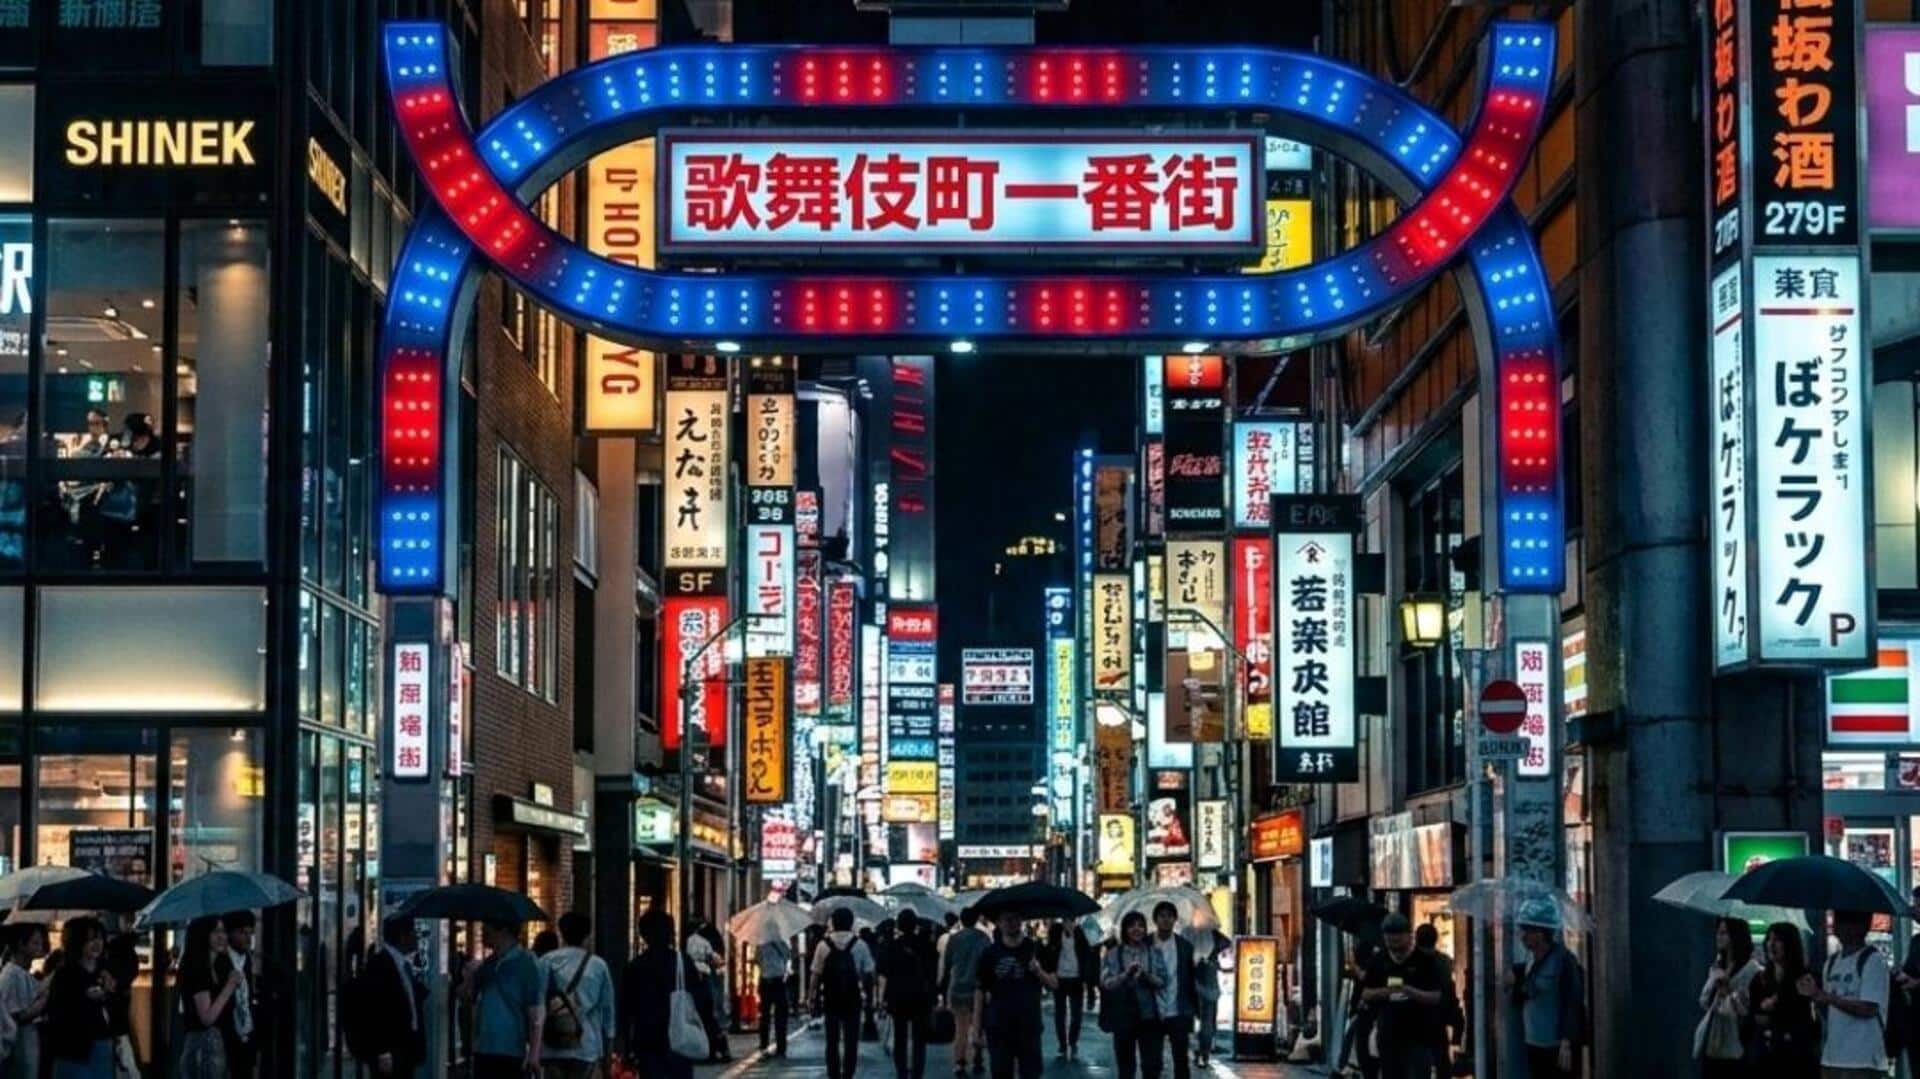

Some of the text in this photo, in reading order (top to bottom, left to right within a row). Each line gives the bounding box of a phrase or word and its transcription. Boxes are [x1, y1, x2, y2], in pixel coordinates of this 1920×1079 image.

[66, 121, 255, 165] SHINEK
[685, 153, 1238, 232] 歌舞伎町一番街
[1764, 201, 1846, 235] 279F
[679, 573, 714, 592] SF
[1829, 612, 1857, 647] P
